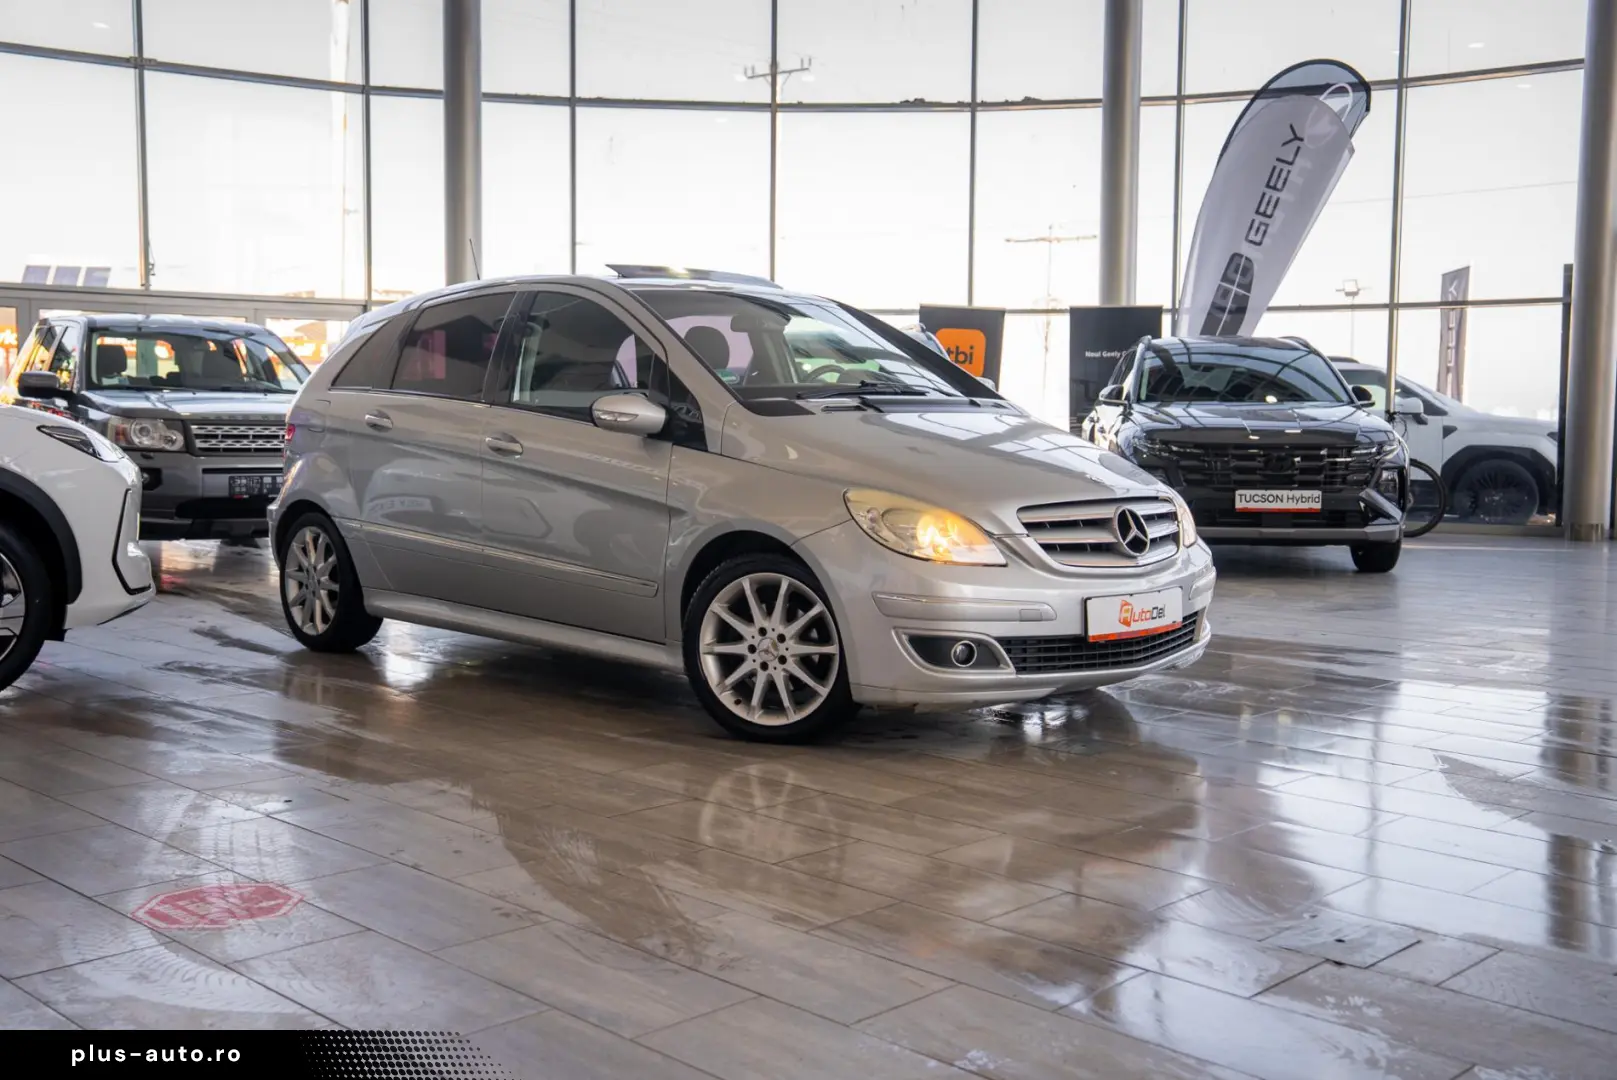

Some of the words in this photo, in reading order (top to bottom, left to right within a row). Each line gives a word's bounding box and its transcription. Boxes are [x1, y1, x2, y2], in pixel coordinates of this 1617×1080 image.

[1245, 123, 1305, 246] GEELY
[946, 345, 974, 365] tbi
[1102, 350, 1121, 359] Geely
[1238, 493, 1283, 503] TUCSON
[1286, 493, 1320, 505] Hybrid
[1119, 600, 1165, 627] AutoDel
